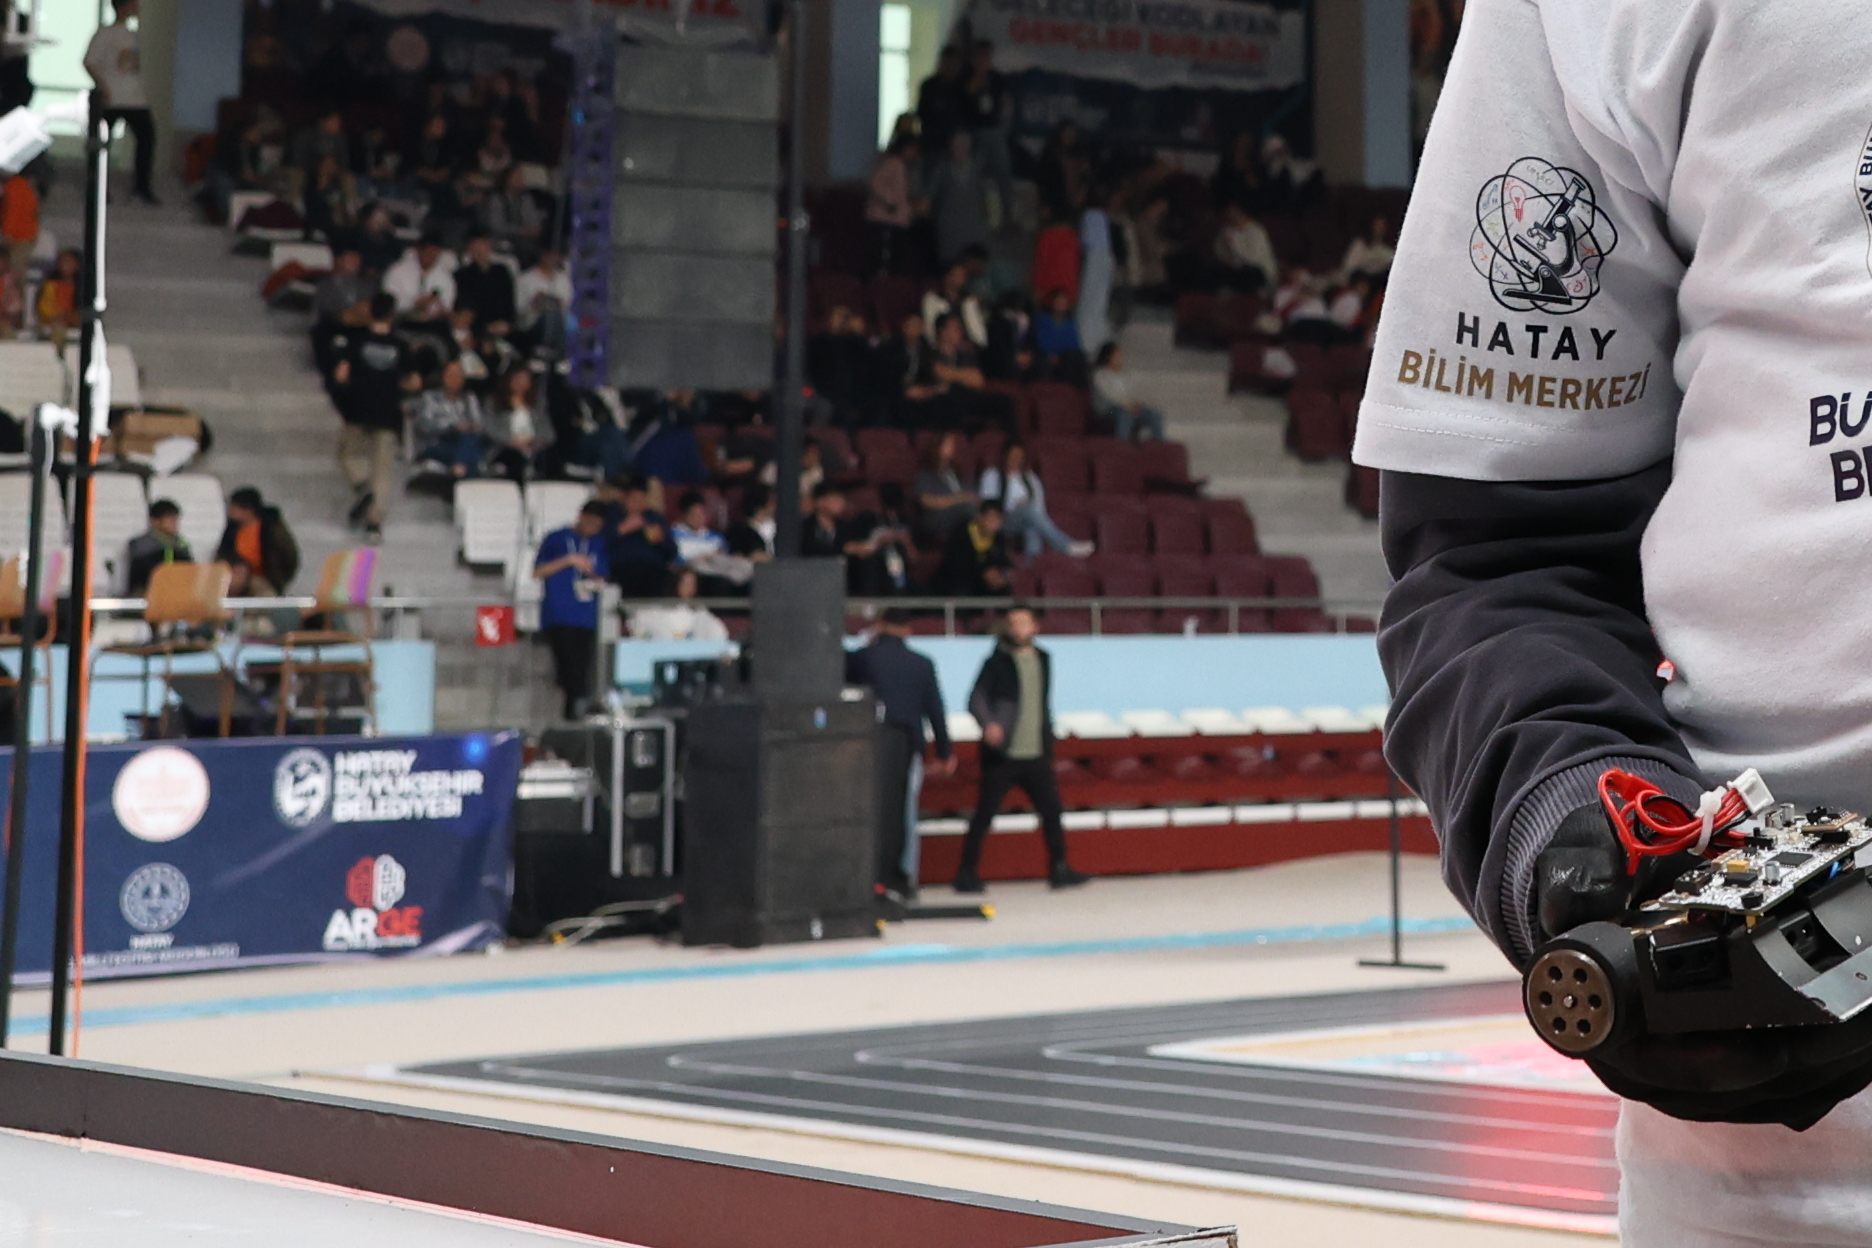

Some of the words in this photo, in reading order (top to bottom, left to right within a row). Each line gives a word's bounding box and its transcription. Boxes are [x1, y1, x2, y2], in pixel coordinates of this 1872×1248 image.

[1456, 311, 1617, 361] HATAY
[1397, 348, 1495, 400] BİLİM
[1507, 362, 1653, 411] MERKEZİ
